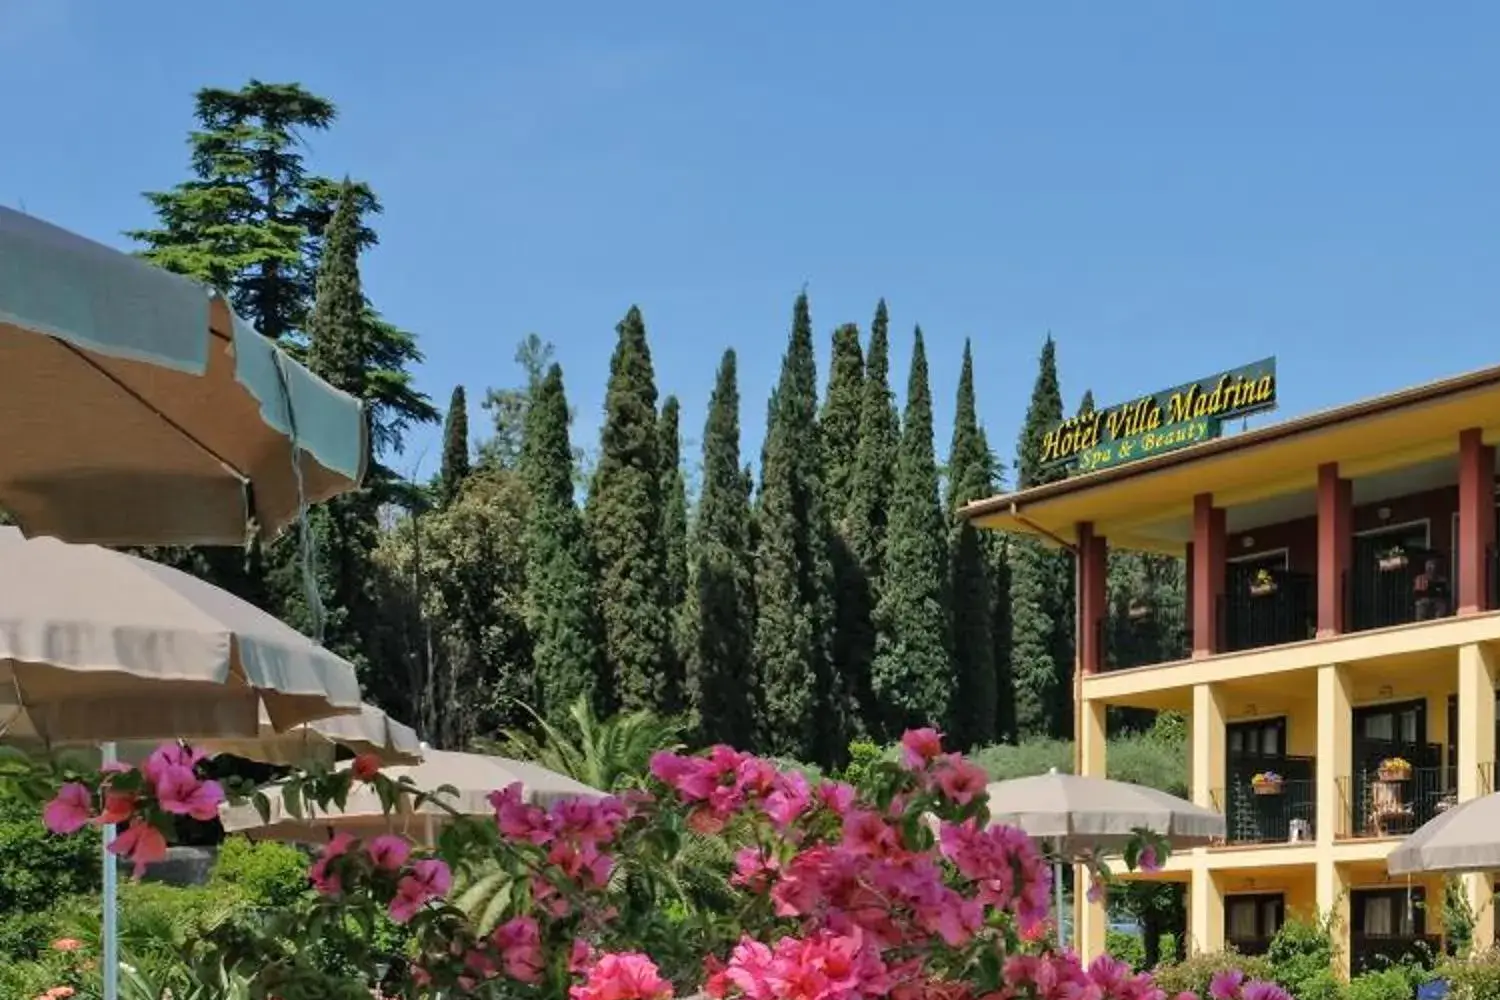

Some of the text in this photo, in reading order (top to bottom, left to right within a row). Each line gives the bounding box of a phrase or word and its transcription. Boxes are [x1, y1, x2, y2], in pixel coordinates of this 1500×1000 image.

[1040, 374, 1271, 463] Hotel Villa Madrina
[1081, 421, 1207, 469] Spa & Beauty
